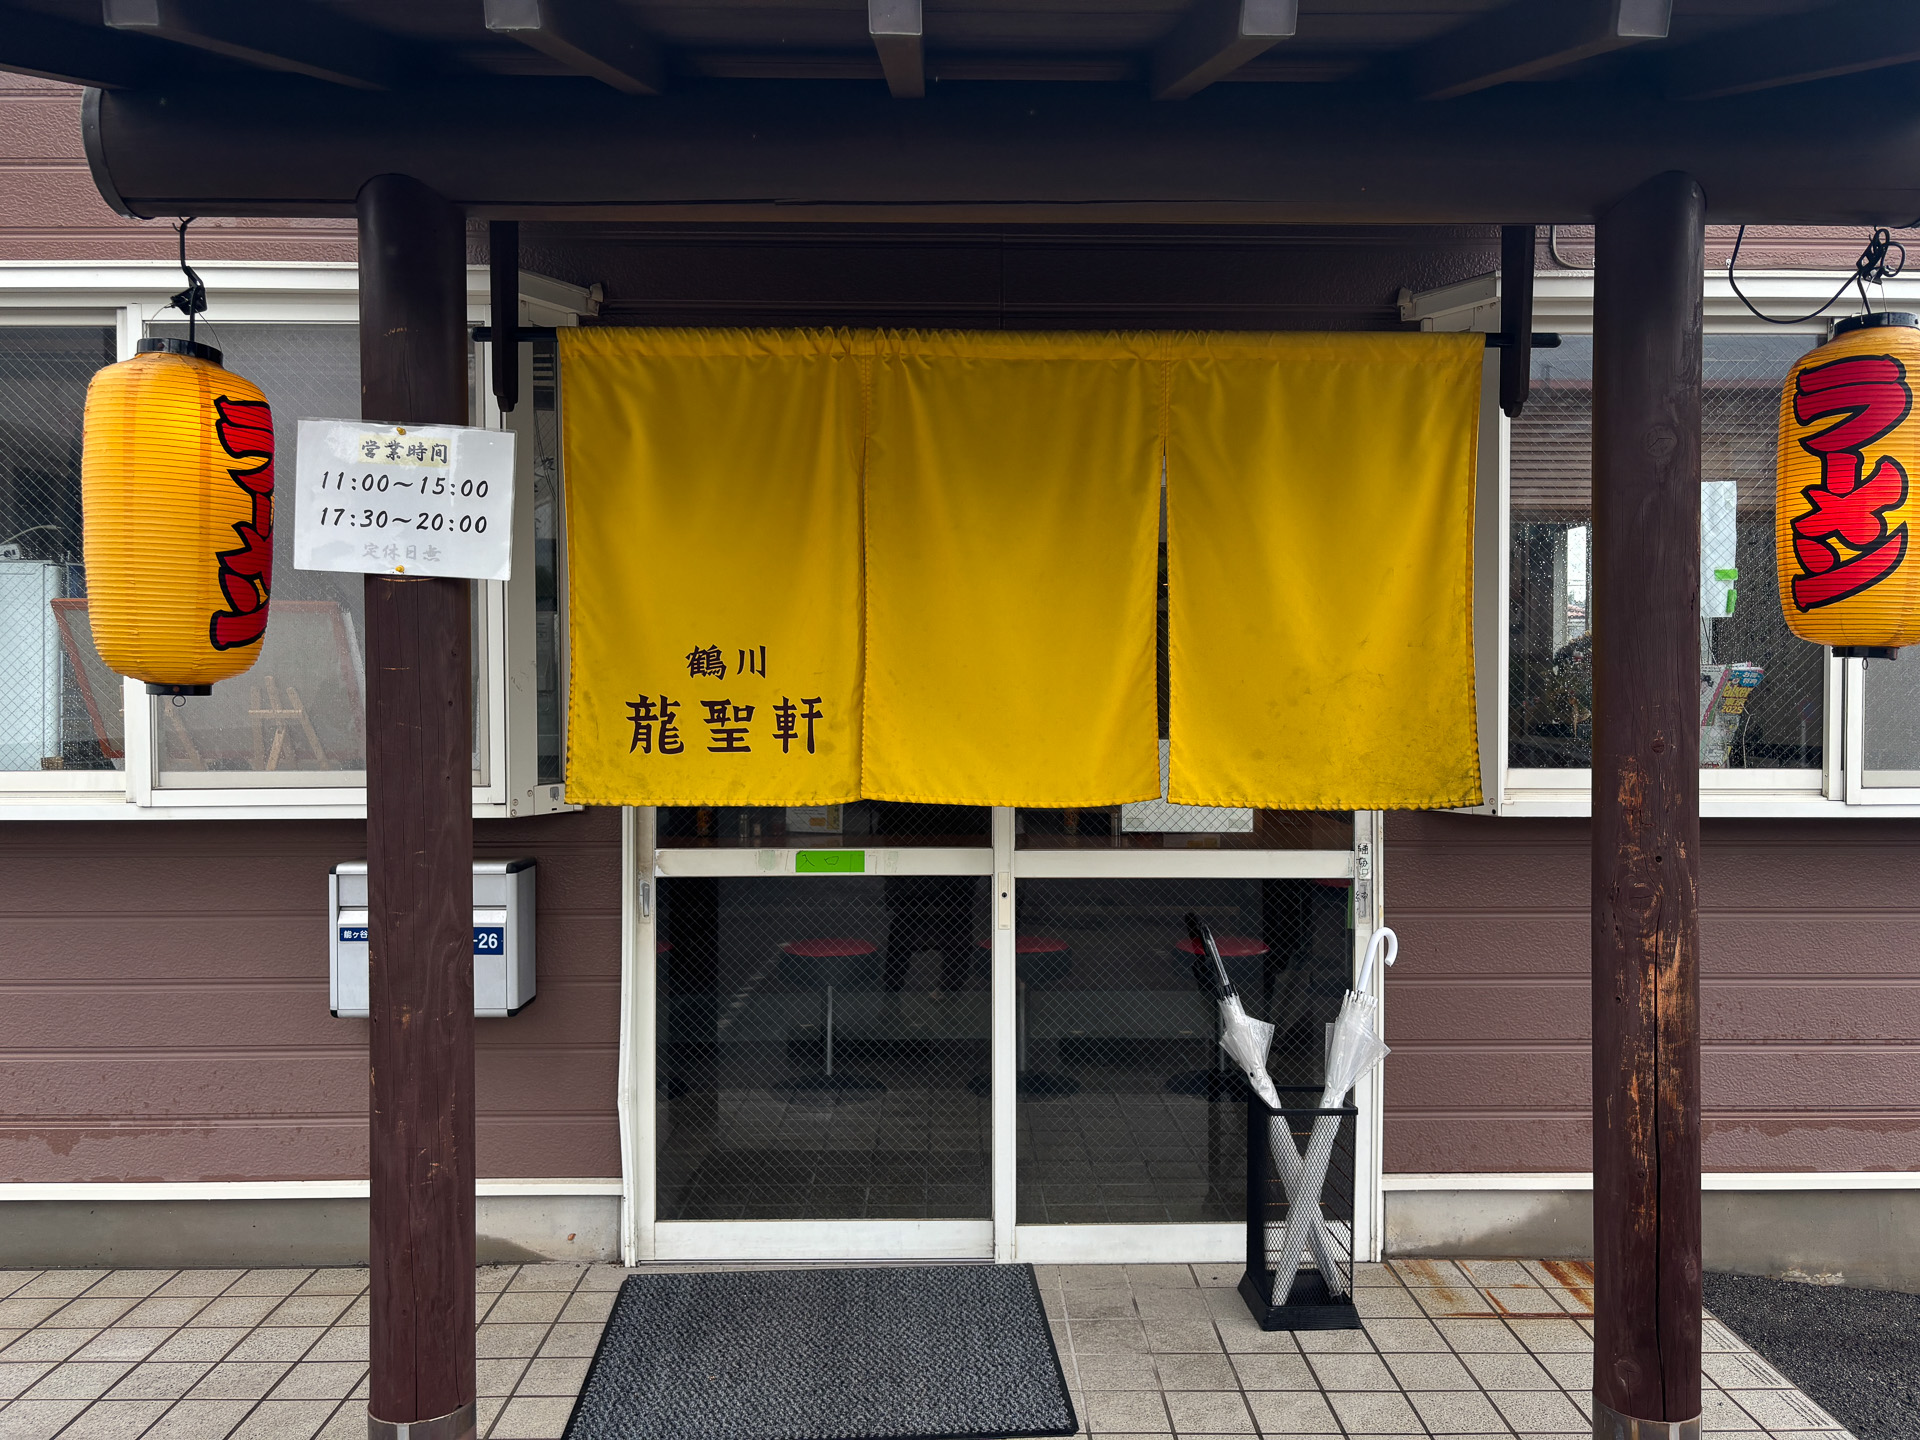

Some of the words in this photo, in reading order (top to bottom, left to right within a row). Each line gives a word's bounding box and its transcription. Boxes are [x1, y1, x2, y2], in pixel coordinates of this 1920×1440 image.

[361, 440, 449, 464] 営業時間
[1790, 354, 1912, 613] ラーメン
[362, 542, 442, 562] 定休日無
[685, 644, 767, 680] 鶴川
[625, 694, 824, 755] 龍聖軒
[1721, 706, 1743, 714] 2025
